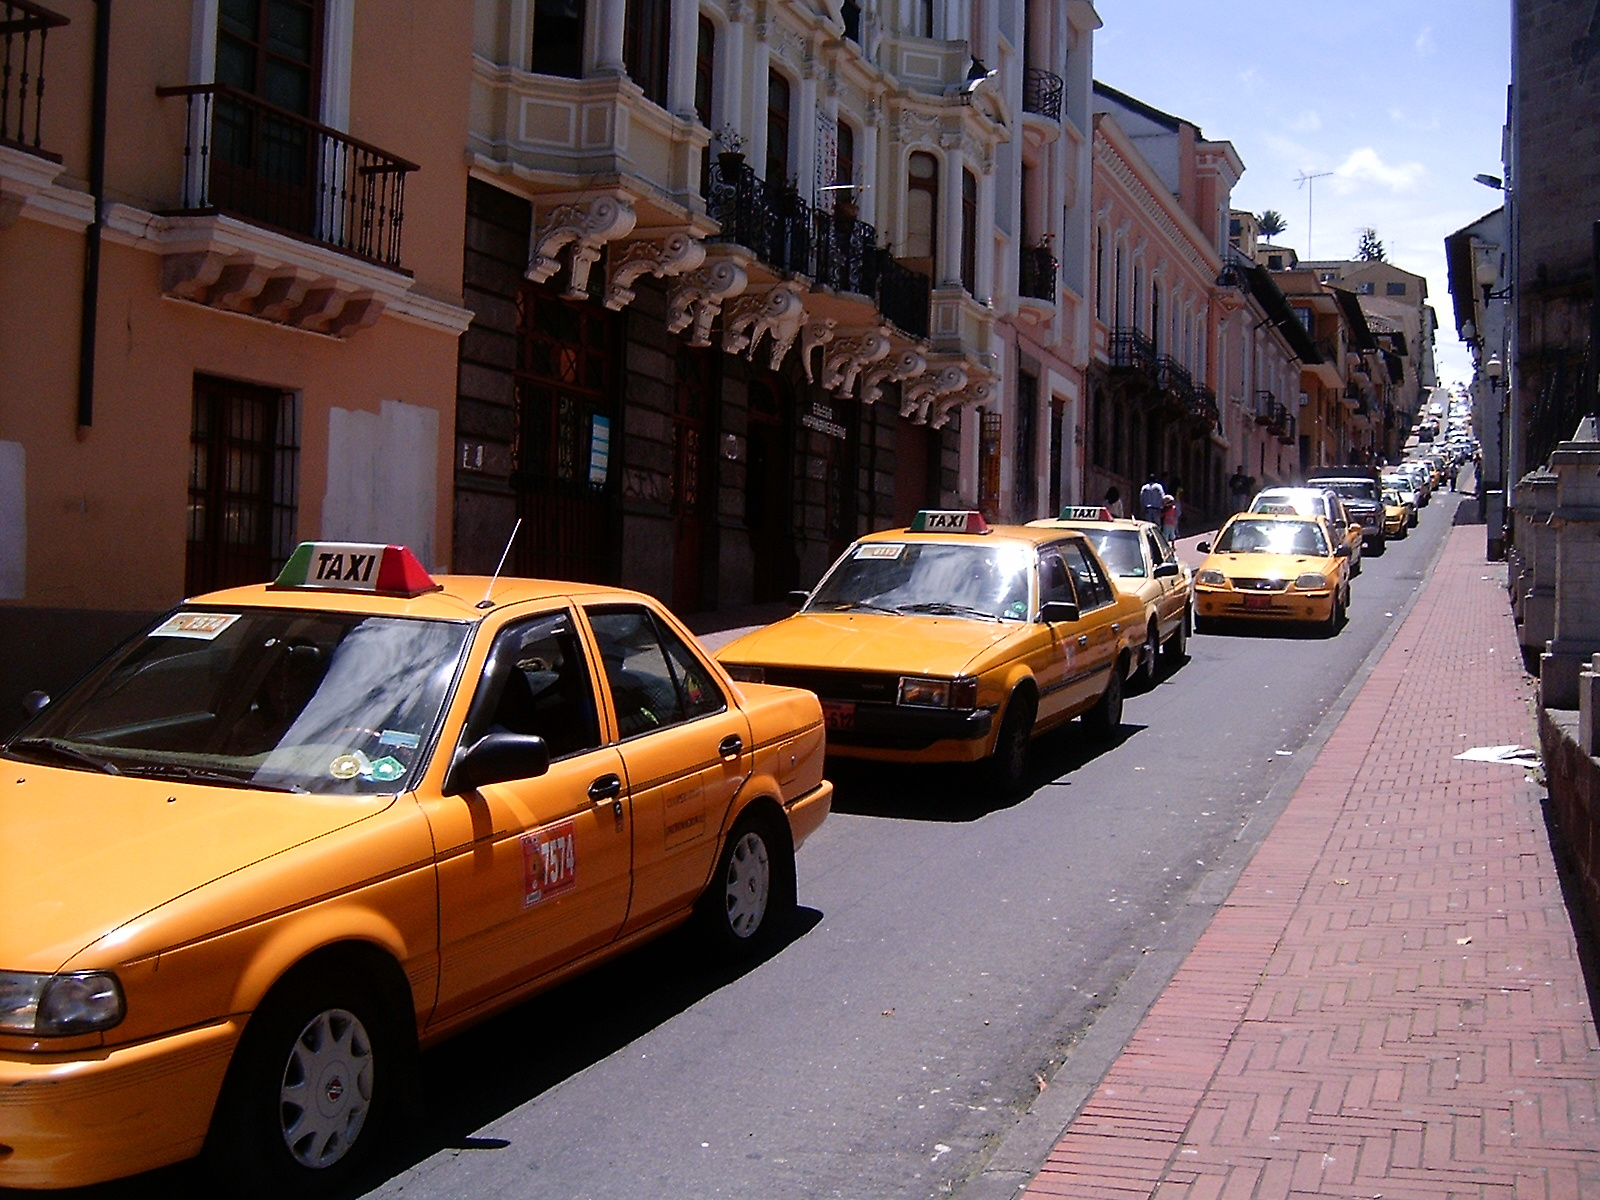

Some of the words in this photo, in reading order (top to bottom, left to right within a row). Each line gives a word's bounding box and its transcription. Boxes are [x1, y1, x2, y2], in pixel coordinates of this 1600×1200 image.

[929, 515, 965, 528] TAXI
[1073, 508, 1096, 518] TAXI
[316, 553, 376, 582] TAXI
[541, 834, 575, 886] 7574
